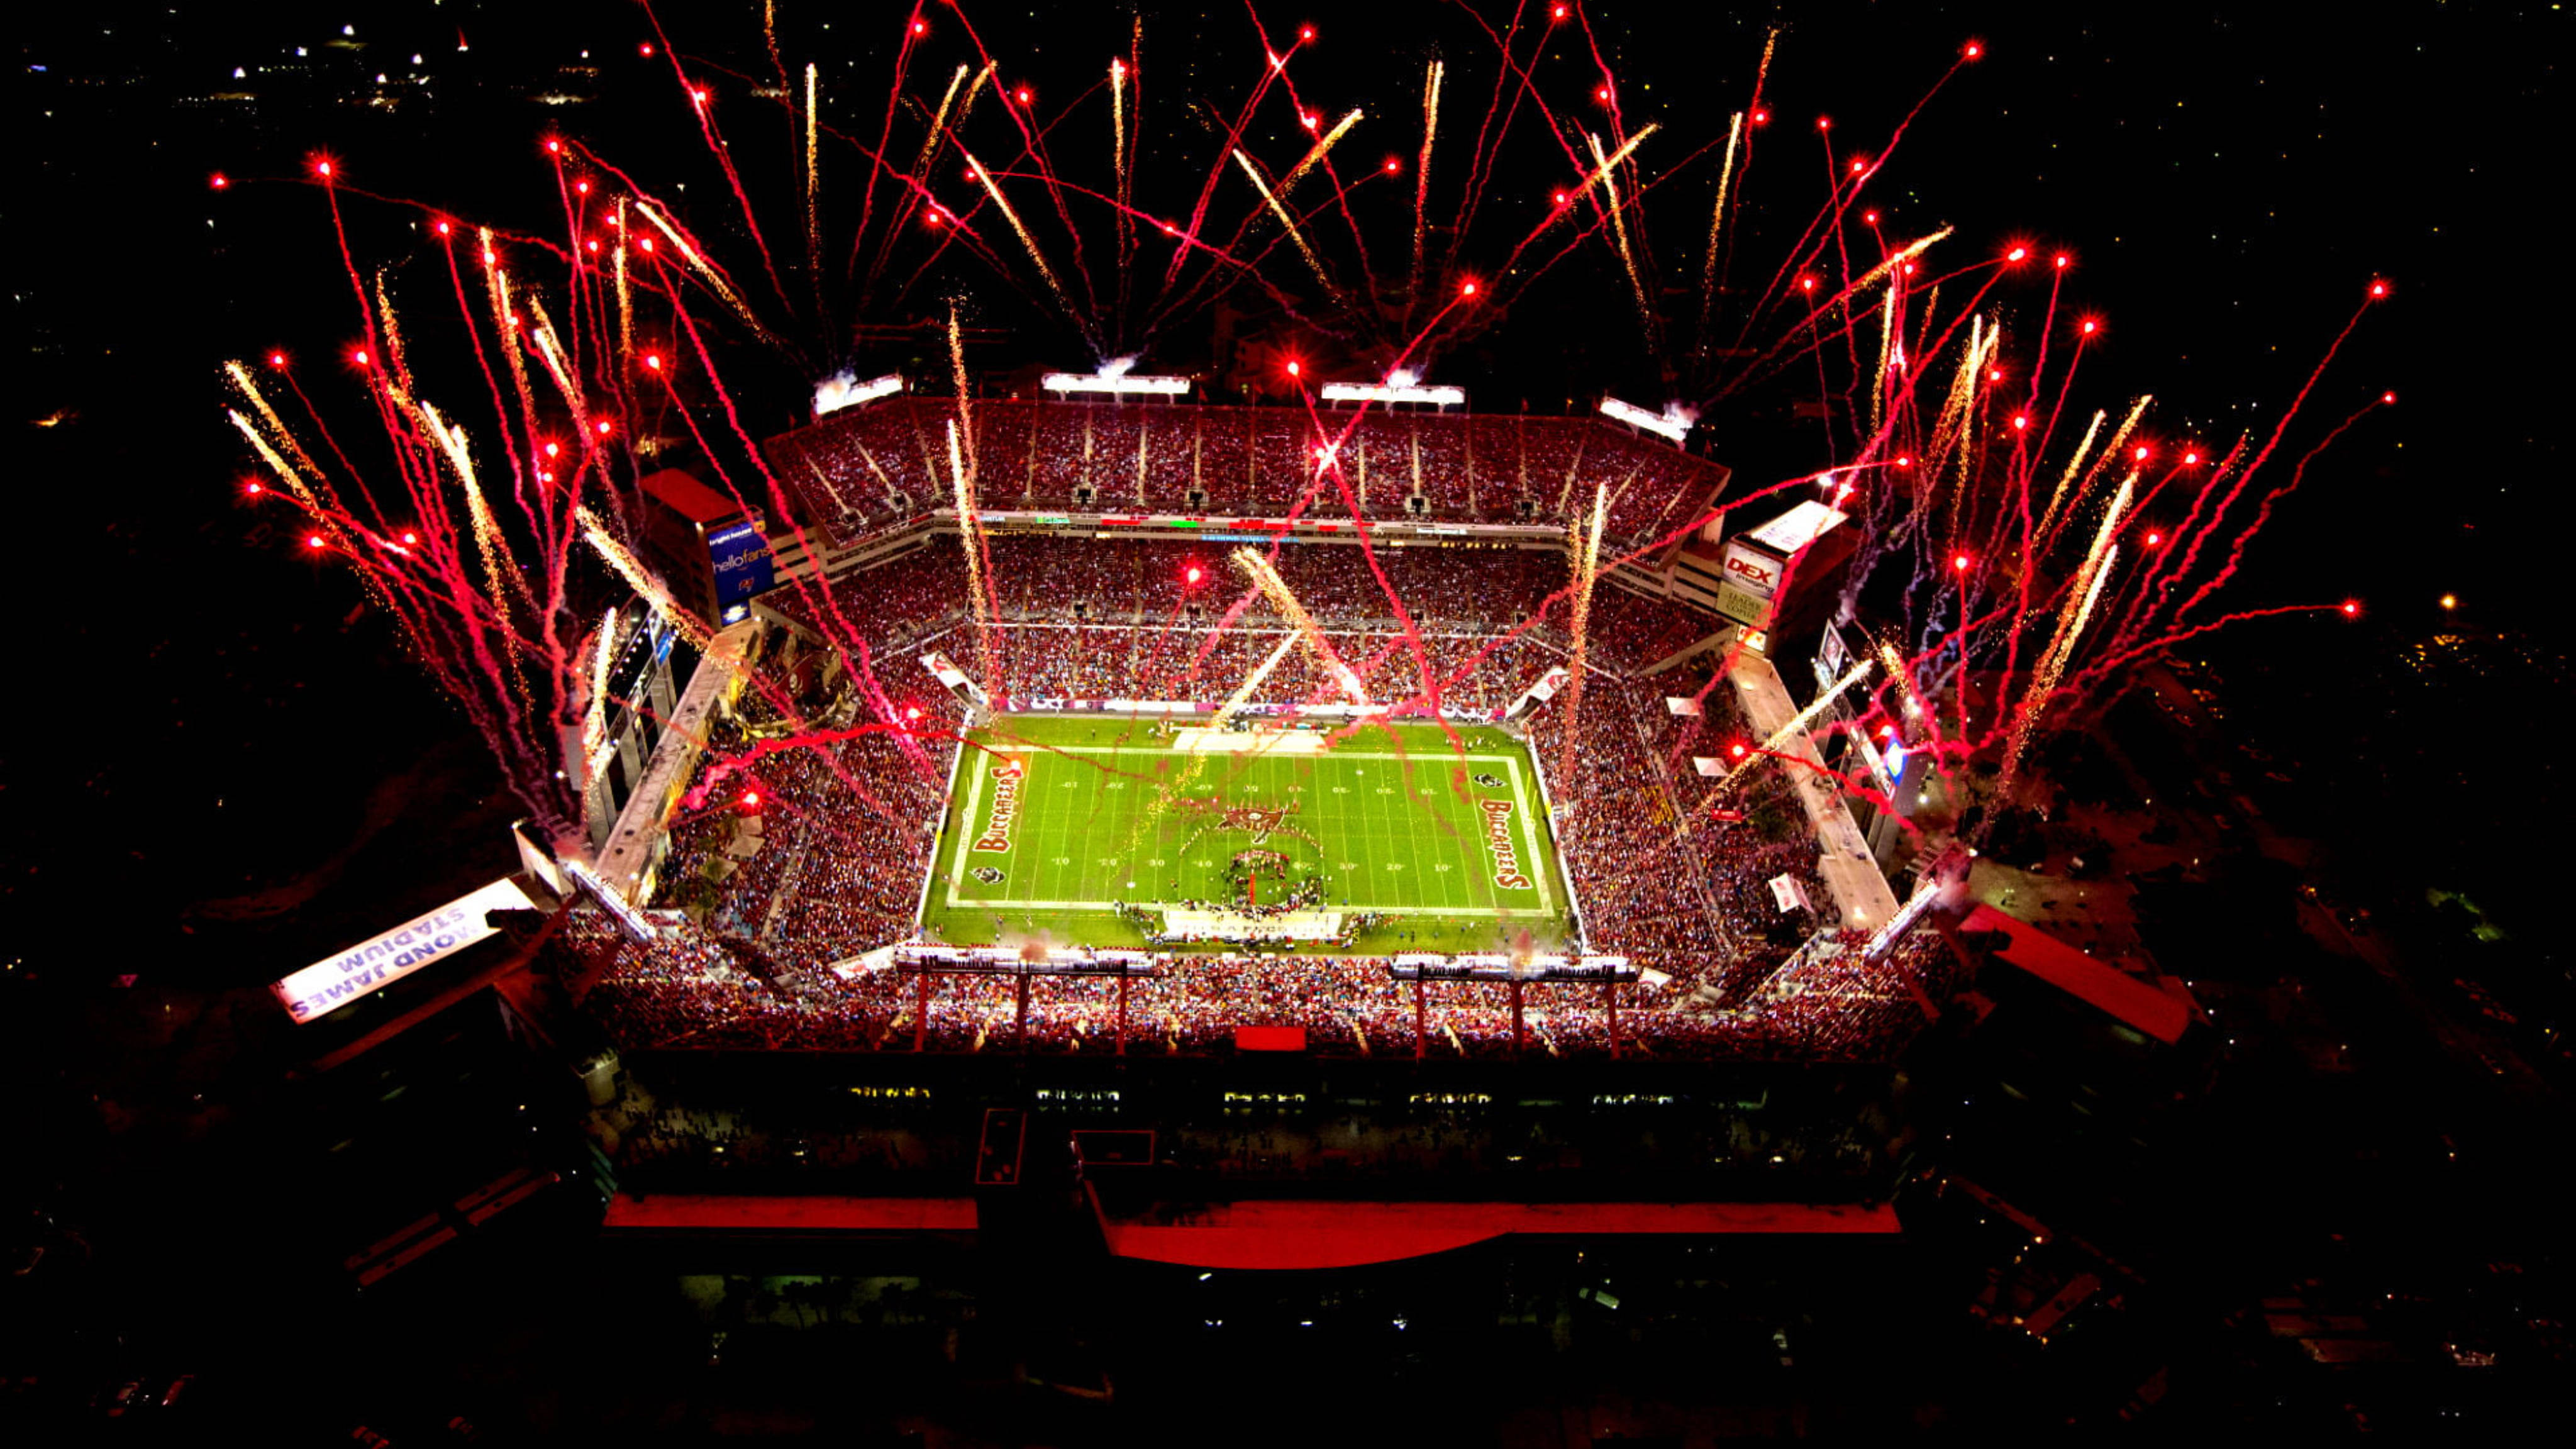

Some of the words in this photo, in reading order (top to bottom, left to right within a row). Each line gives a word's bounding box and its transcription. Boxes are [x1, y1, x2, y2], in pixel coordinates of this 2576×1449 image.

[1726, 557, 1774, 584] DEX
[336, 908, 465, 973] STADIUM
[290, 963, 386, 1018] JAMES
